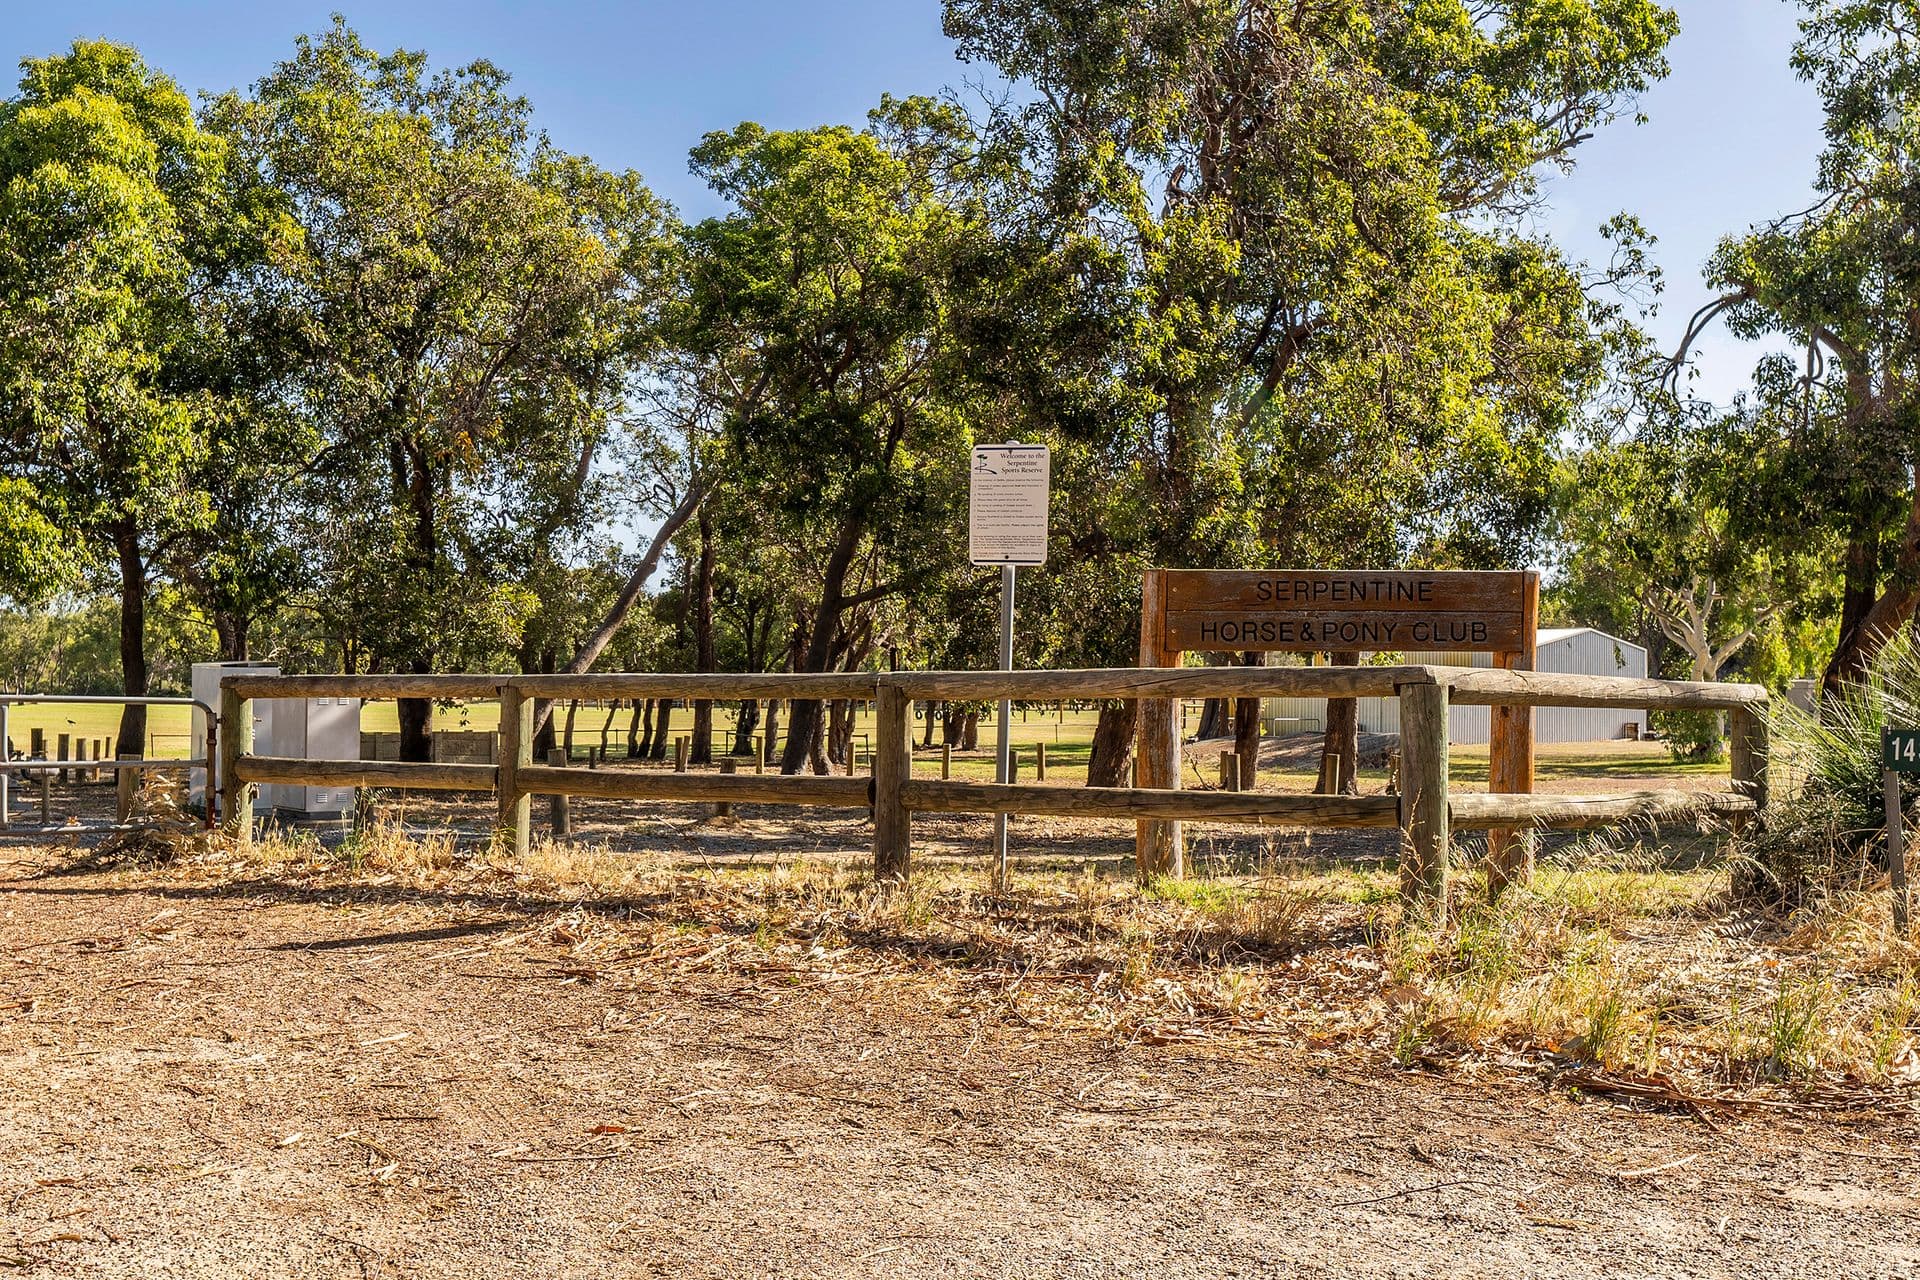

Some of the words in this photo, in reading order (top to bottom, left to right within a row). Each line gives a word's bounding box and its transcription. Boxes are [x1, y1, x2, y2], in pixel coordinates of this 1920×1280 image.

[1256, 580, 1434, 602] SERPENTINE
[1412, 621, 1487, 642] CLUB
[1891, 736, 1920, 762] 14
